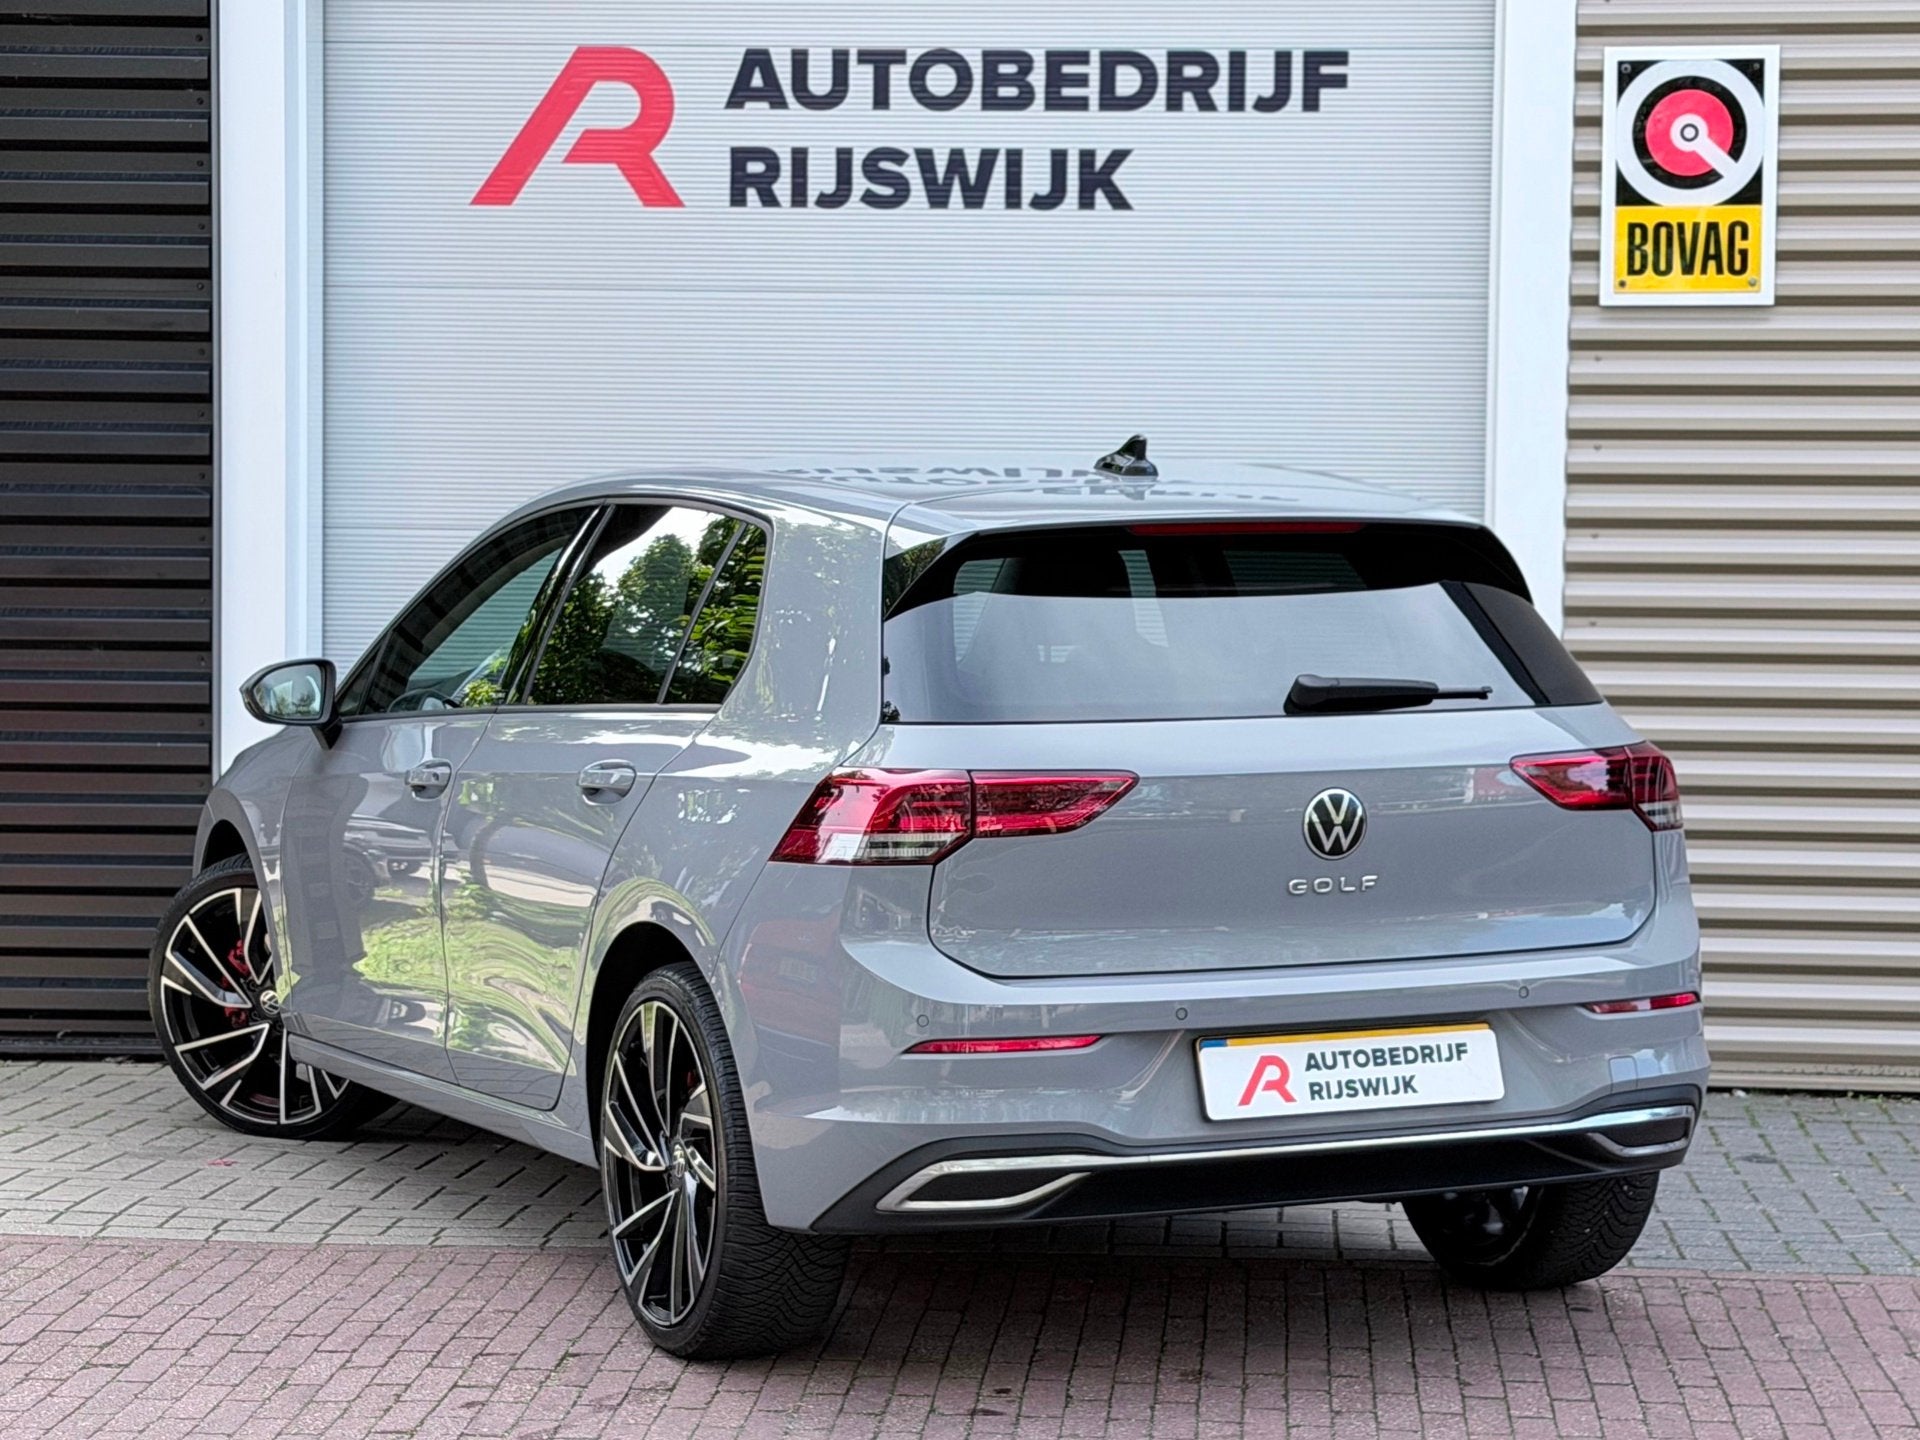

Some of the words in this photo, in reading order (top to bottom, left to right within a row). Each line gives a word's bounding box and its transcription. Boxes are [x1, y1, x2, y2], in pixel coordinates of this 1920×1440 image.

[725, 48, 1349, 113] AUTOBEDRIJF
[729, 146, 1133, 211] RIJSWIJK
[1627, 220, 1749, 277] BOVAG
[1288, 875, 1379, 895] GOLF
[1304, 1042, 1469, 1072] AUTOBEDRIJF
[1308, 1074, 1419, 1101] RIJSWIJK
